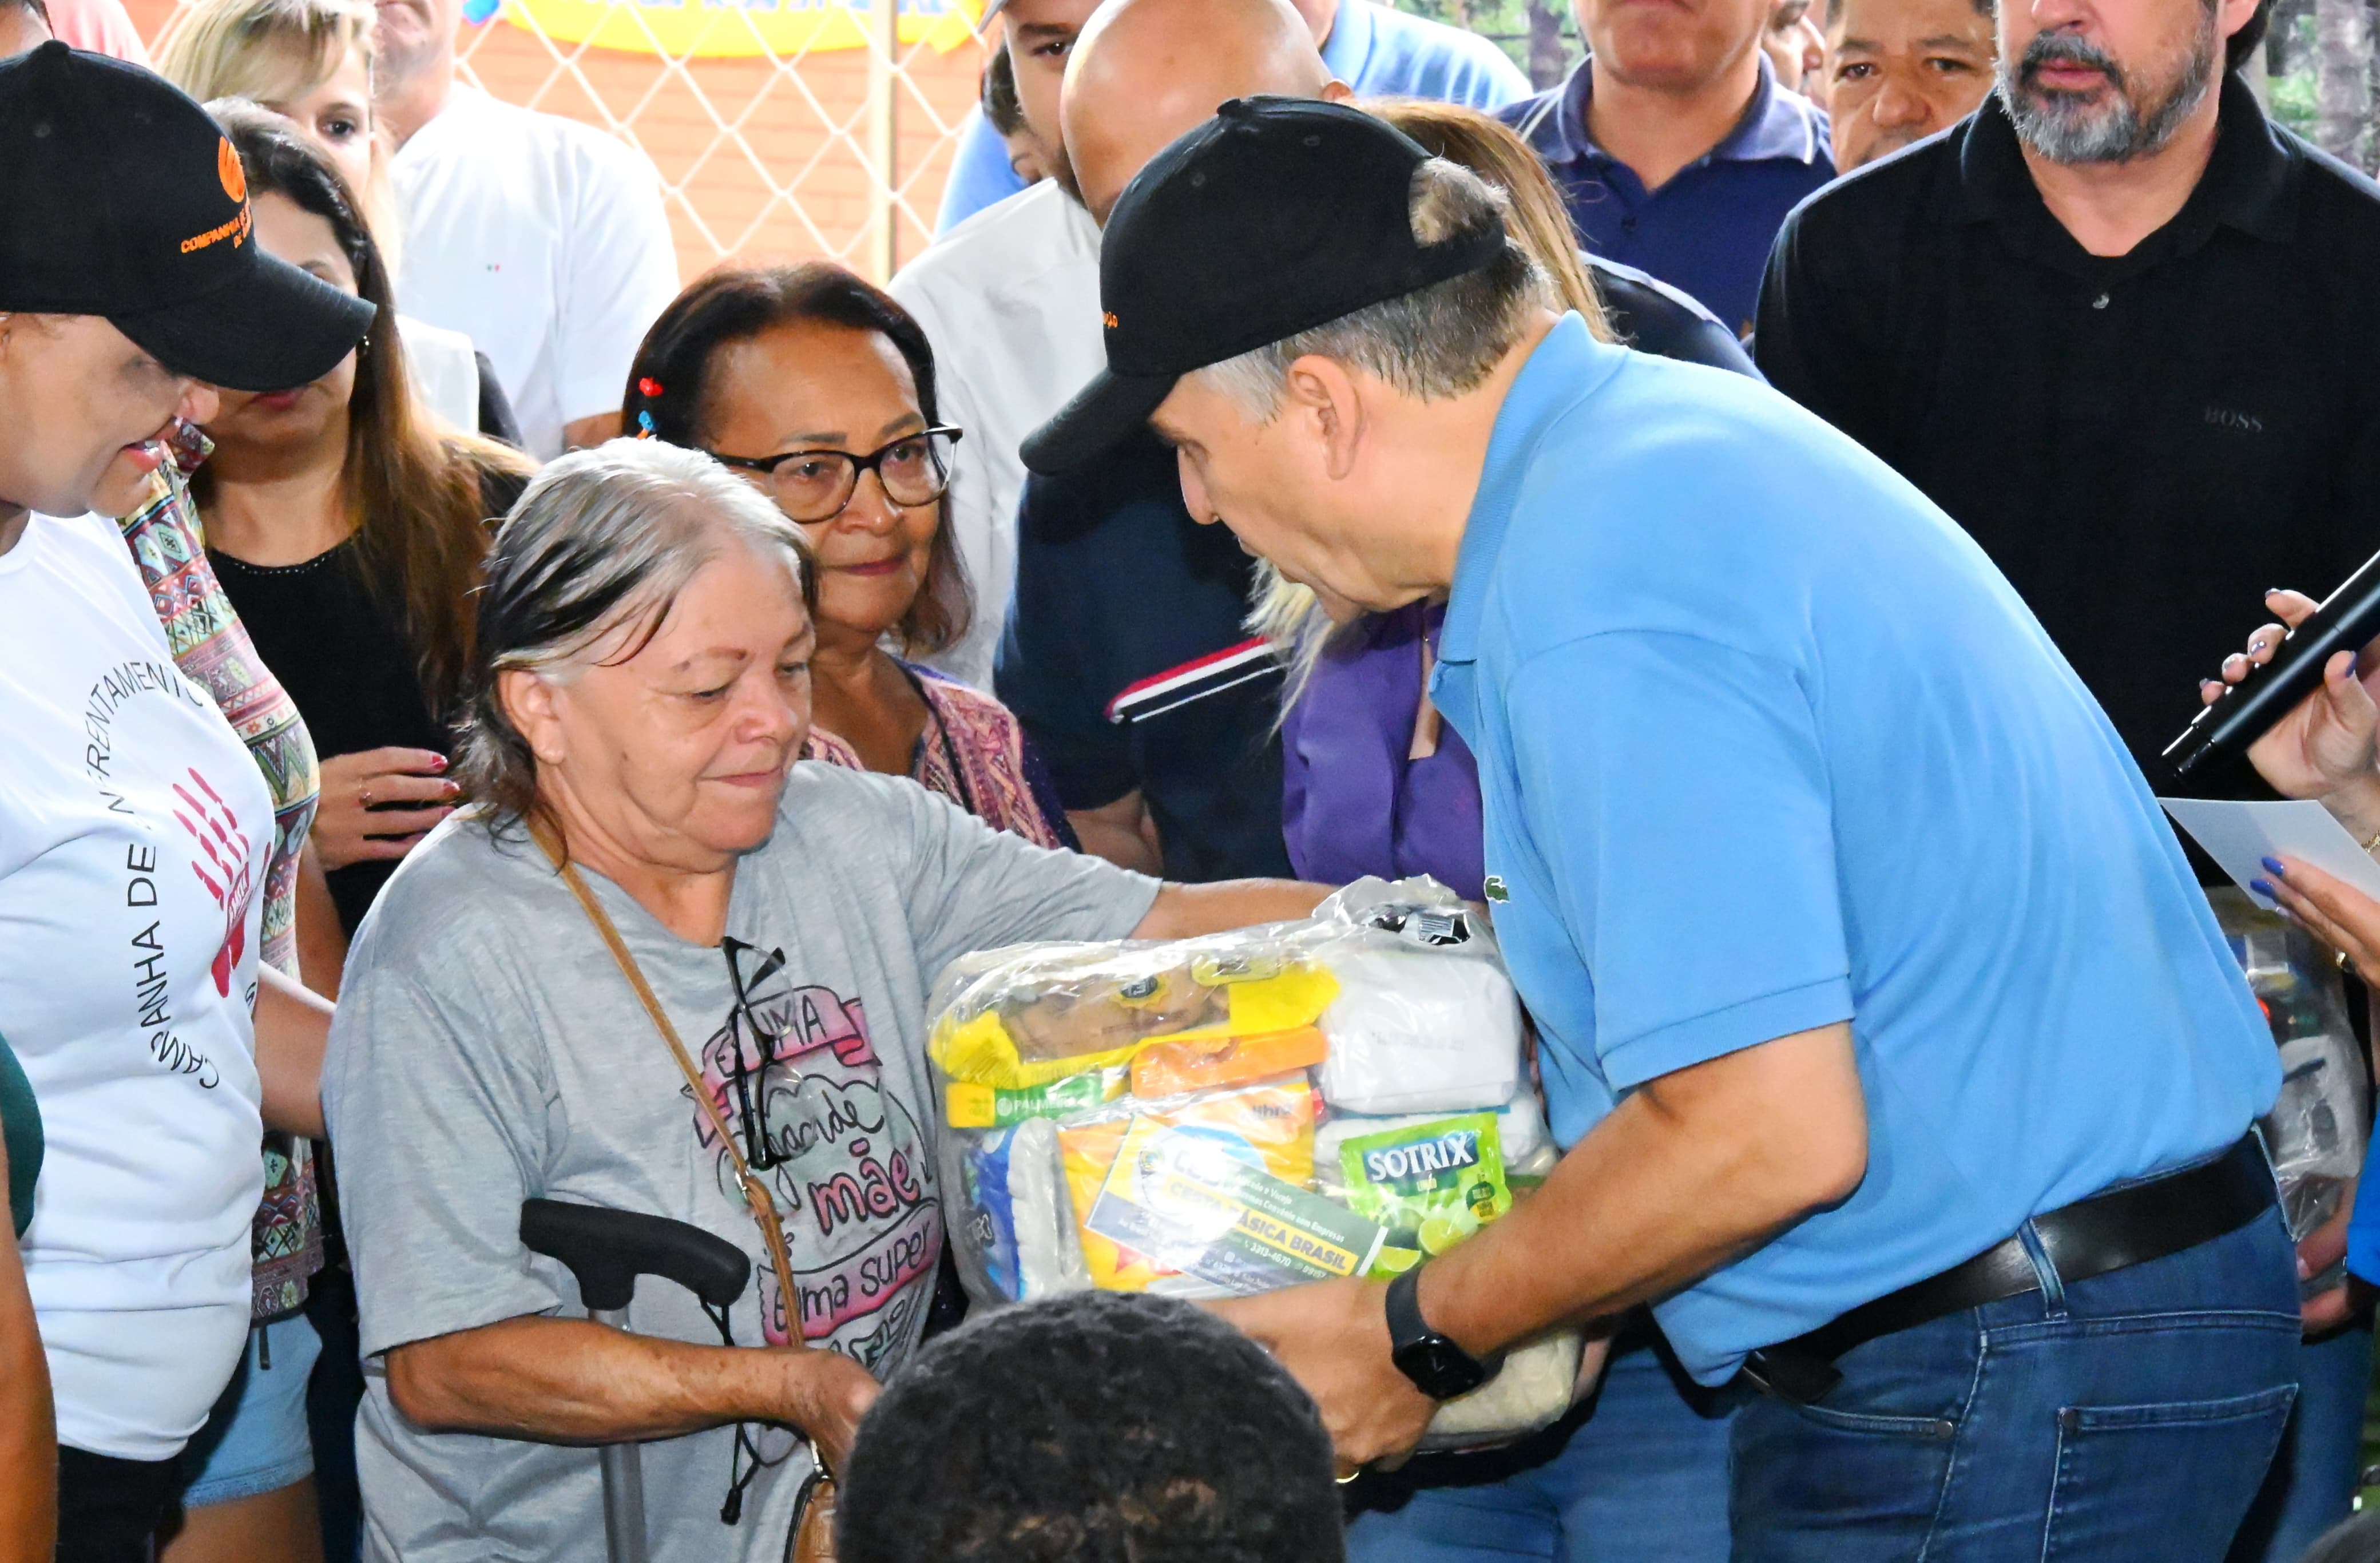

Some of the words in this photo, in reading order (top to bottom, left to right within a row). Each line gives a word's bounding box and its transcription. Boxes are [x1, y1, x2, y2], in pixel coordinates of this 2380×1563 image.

[2204, 406, 2262, 433] BOSS
[85, 661, 203, 830] NRENTAMENT
[127, 843, 158, 907] DE
[131, 919, 219, 1089] CAMPANHA
[1367, 1130, 1474, 1182] SOTRIX
[1224, 1202, 1287, 1245] ÁSICA
[1289, 1233, 1346, 1270] BRASIL
[1310, 1220, 1346, 1244] Empresas
